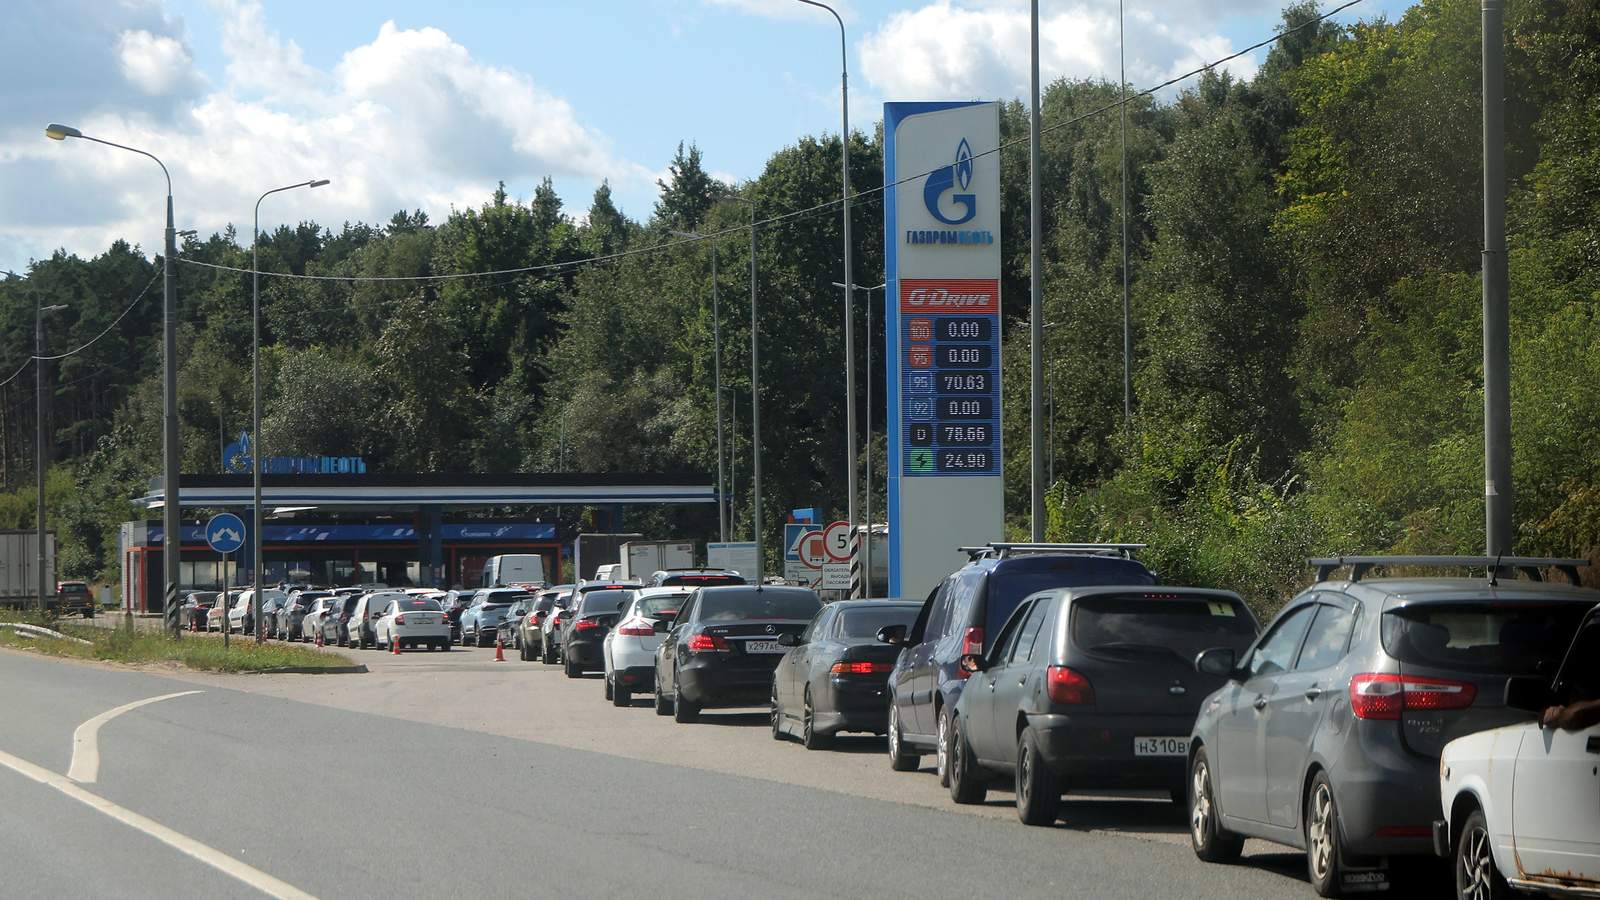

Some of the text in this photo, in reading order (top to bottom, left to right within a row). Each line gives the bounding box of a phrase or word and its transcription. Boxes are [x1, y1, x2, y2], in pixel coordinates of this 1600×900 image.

[911, 322, 980, 339] 100 0.00
[913, 349, 980, 365] 95 0.00
[913, 375, 985, 390] 95 70.63
[914, 401, 981, 415] 92 0.00
[945, 427, 986, 441] 78.66
[945, 453, 987, 468] 24.90
[837, 534, 847, 549] 5
[1139, 738, 1190, 753] Н310В
